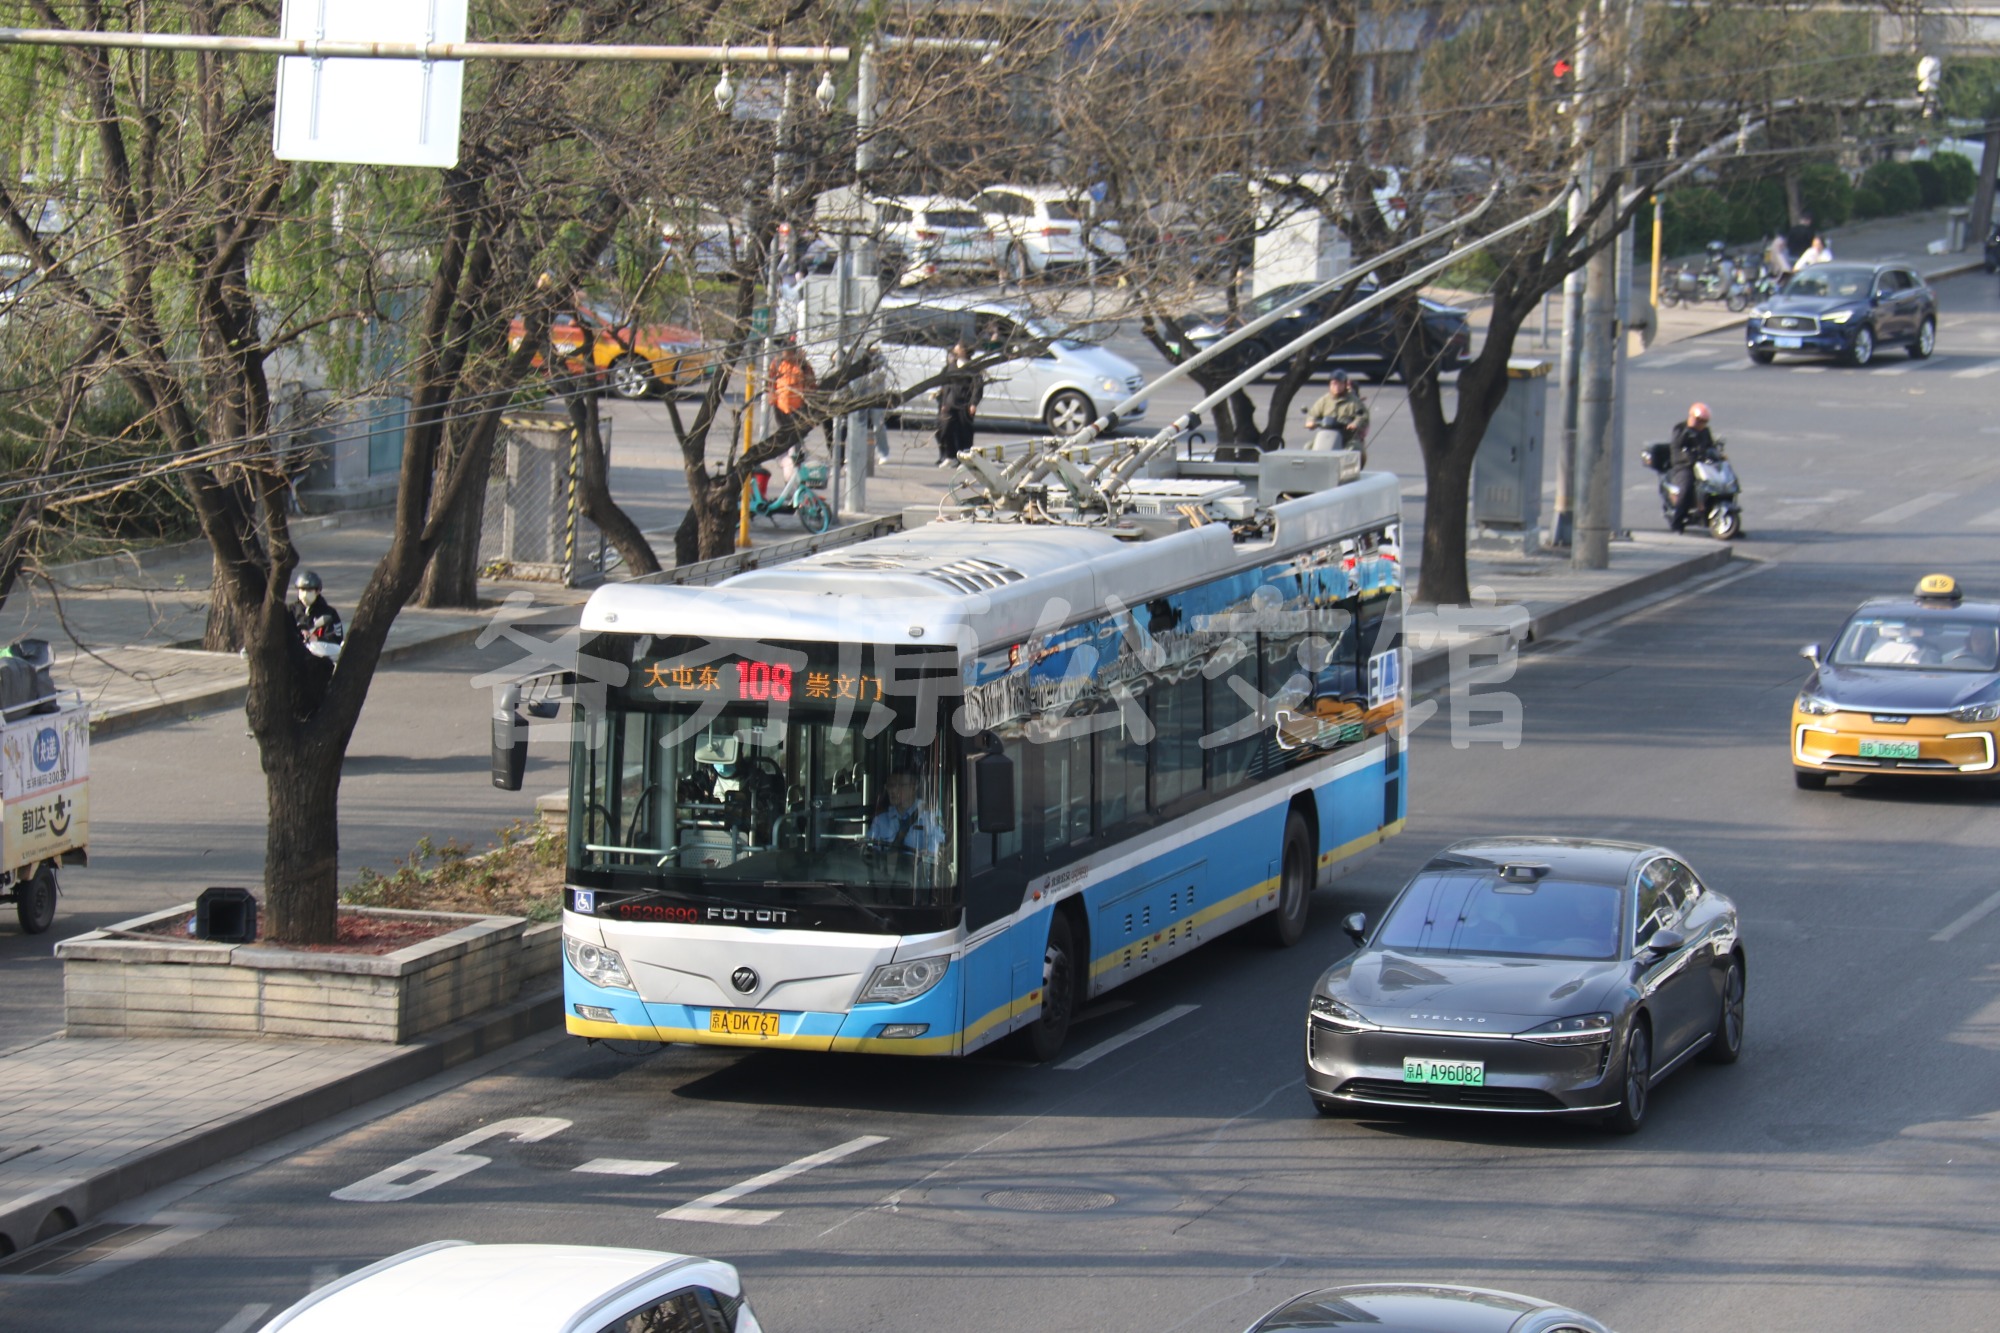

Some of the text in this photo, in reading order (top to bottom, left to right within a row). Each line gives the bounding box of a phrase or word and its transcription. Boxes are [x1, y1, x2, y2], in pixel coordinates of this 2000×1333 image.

[644, 661, 883, 702] 大屯东 108 崇文门
[36, 734, 57, 762] 快递
[22, 804, 47, 835] 韵达
[620, 905, 787, 923] 9528690 FOTON
[1410, 1014, 1486, 1023] STELATO
